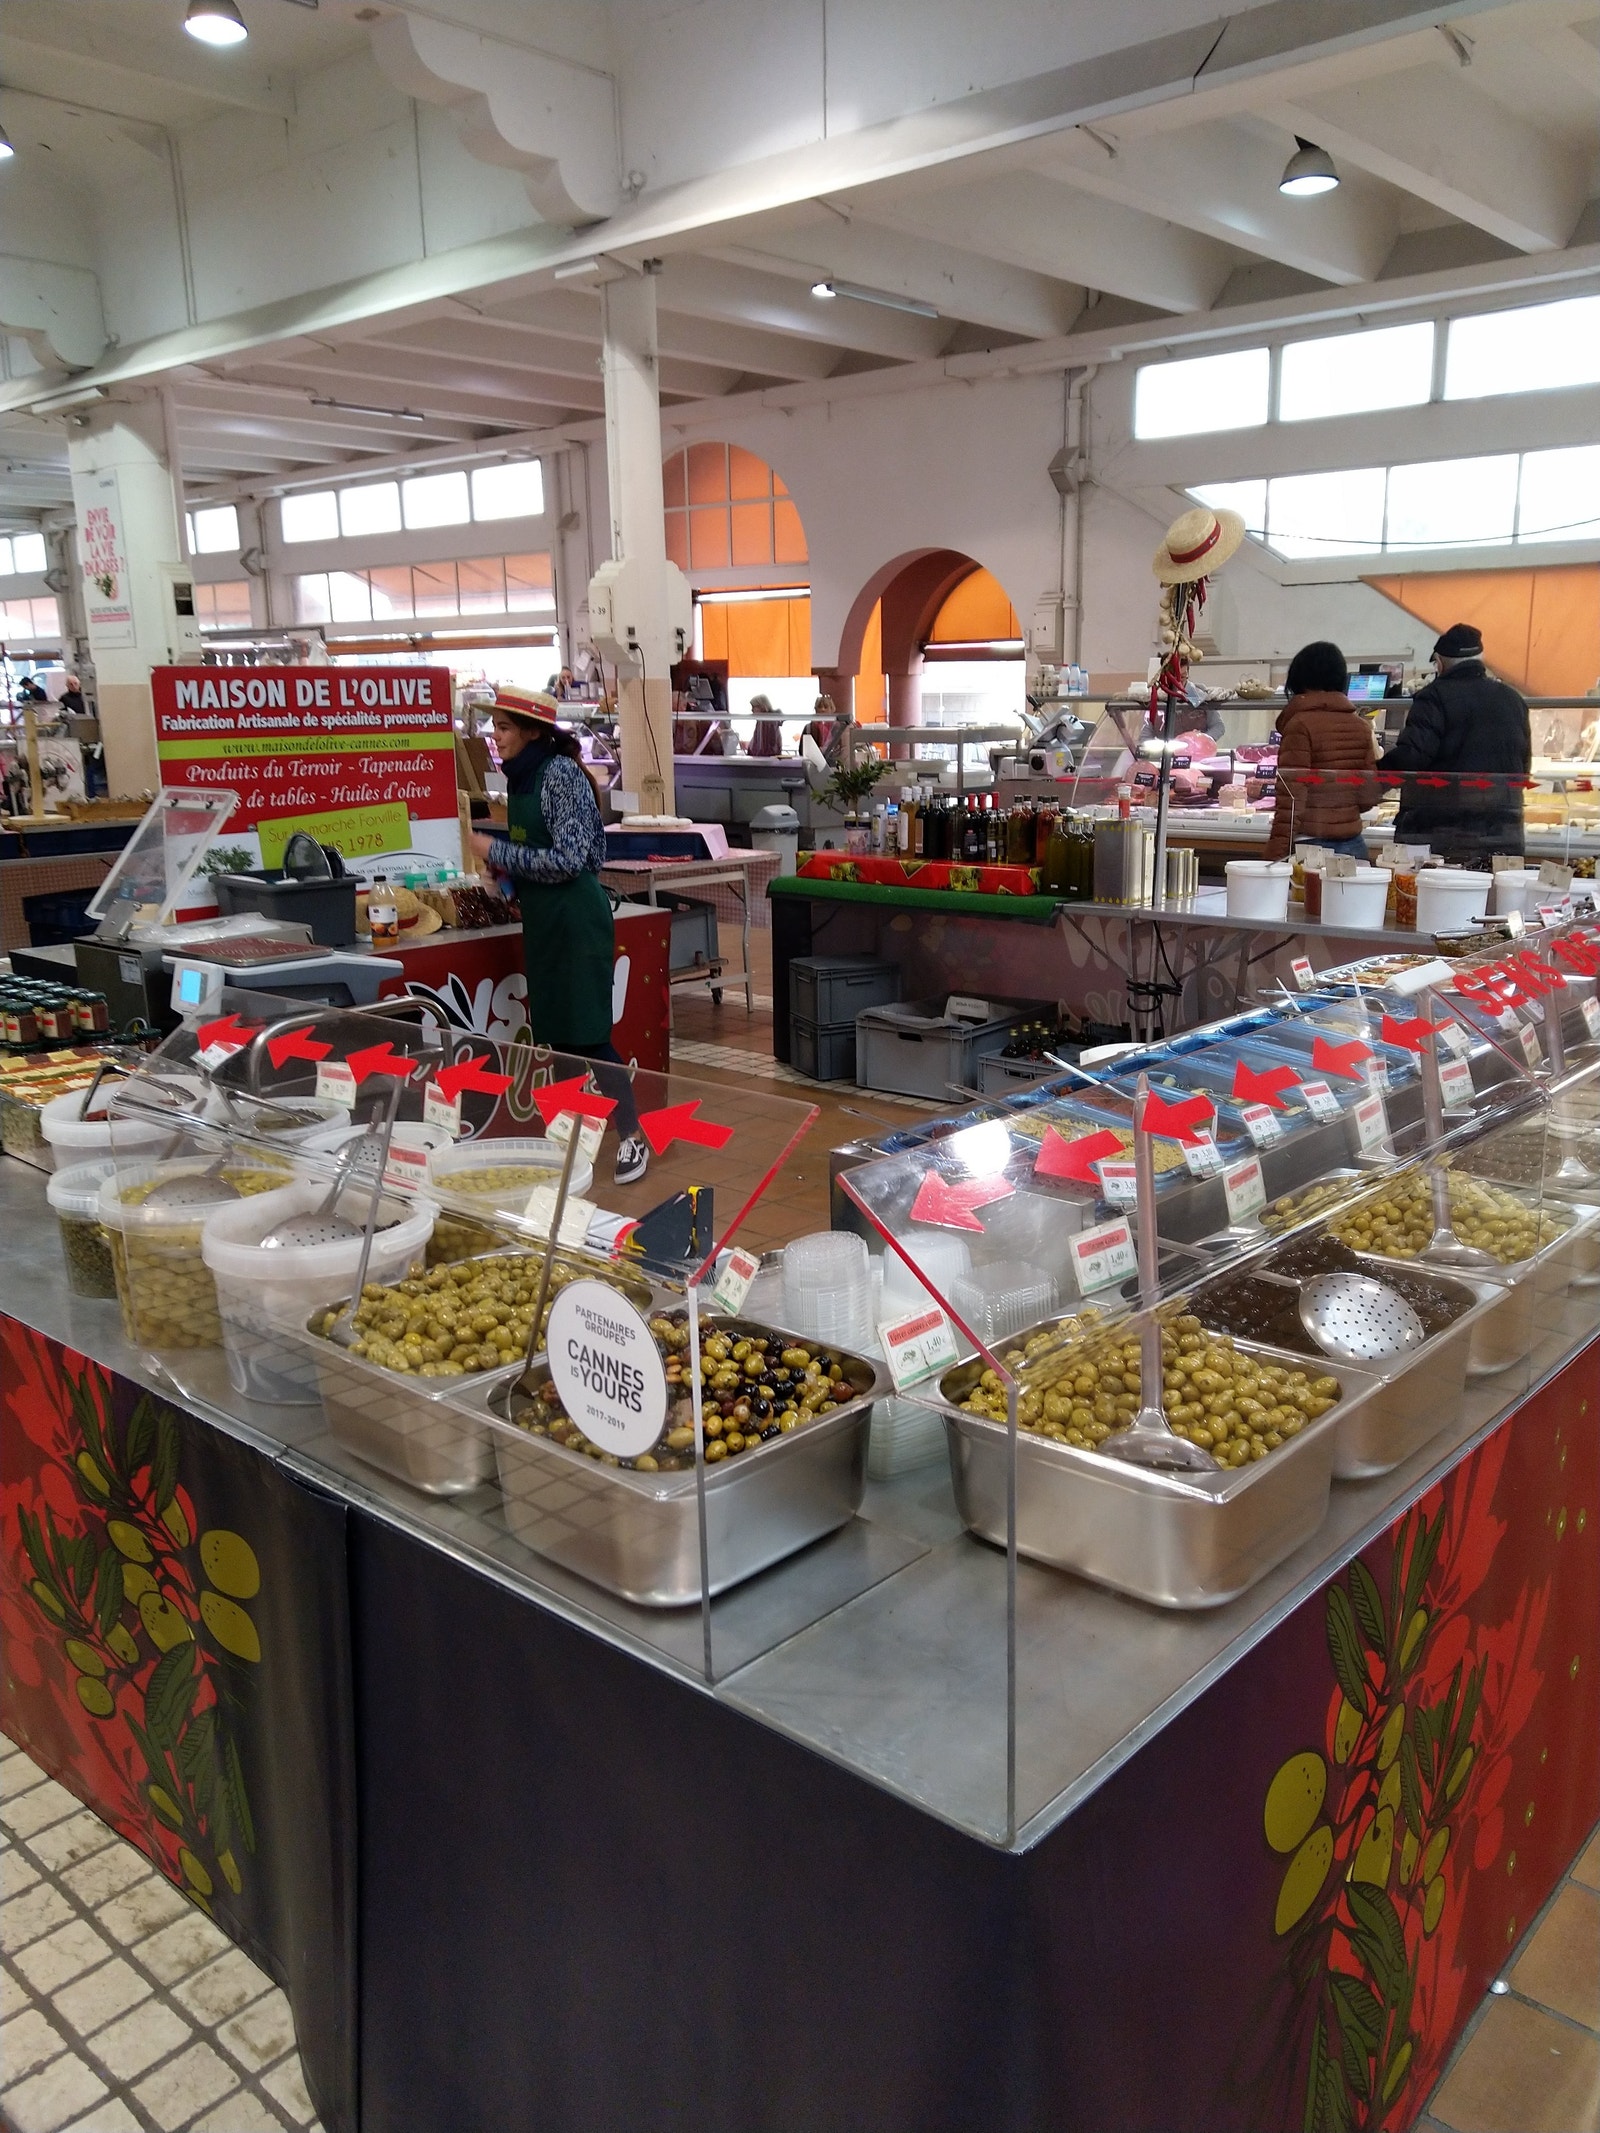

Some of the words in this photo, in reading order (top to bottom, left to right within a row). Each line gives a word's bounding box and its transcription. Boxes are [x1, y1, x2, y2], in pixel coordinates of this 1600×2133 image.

[96, 525, 116, 541] VOIR
[90, 545, 100, 559] LA
[102, 541, 115, 557] VIE
[175, 678, 287, 709] MAISON
[295, 678, 331, 708] DE
[339, 678, 433, 707] L'OLIVE
[161, 714, 235, 731] Fabrication
[237, 712, 301, 729] Artisanale
[302, 711, 319, 728] de
[320, 710, 382, 731] spécialités
[384, 709, 448, 729] provençales
[222, 735, 410, 755] www.maisondelolive-cannes.com
[186, 761, 259, 782] Produits
[263, 759, 284, 779] du
[288, 758, 343, 777] Terroir
[358, 753, 434, 778] Tapenades
[246, 788, 265, 808] de
[270, 786, 316, 808] tables
[330, 782, 380, 804] Huiles
[383, 780, 432, 800] d'olive
[268, 827, 288, 843] Sur
[359, 809, 403, 828] Forville
[348, 832, 384, 852] 1978
[1452, 950, 1568, 1017] SENS
[575, 1304, 636, 1341] PARTENAIRES
[585, 1321, 626, 1347] GROUPES
[926, 1335, 941, 1351] 1,40
[567, 1338, 645, 1393] CANNES
[570, 1364, 580, 1379] IS
[579, 1364, 643, 1413] YOURS
[586, 1404, 626, 1431] 2017-2019
